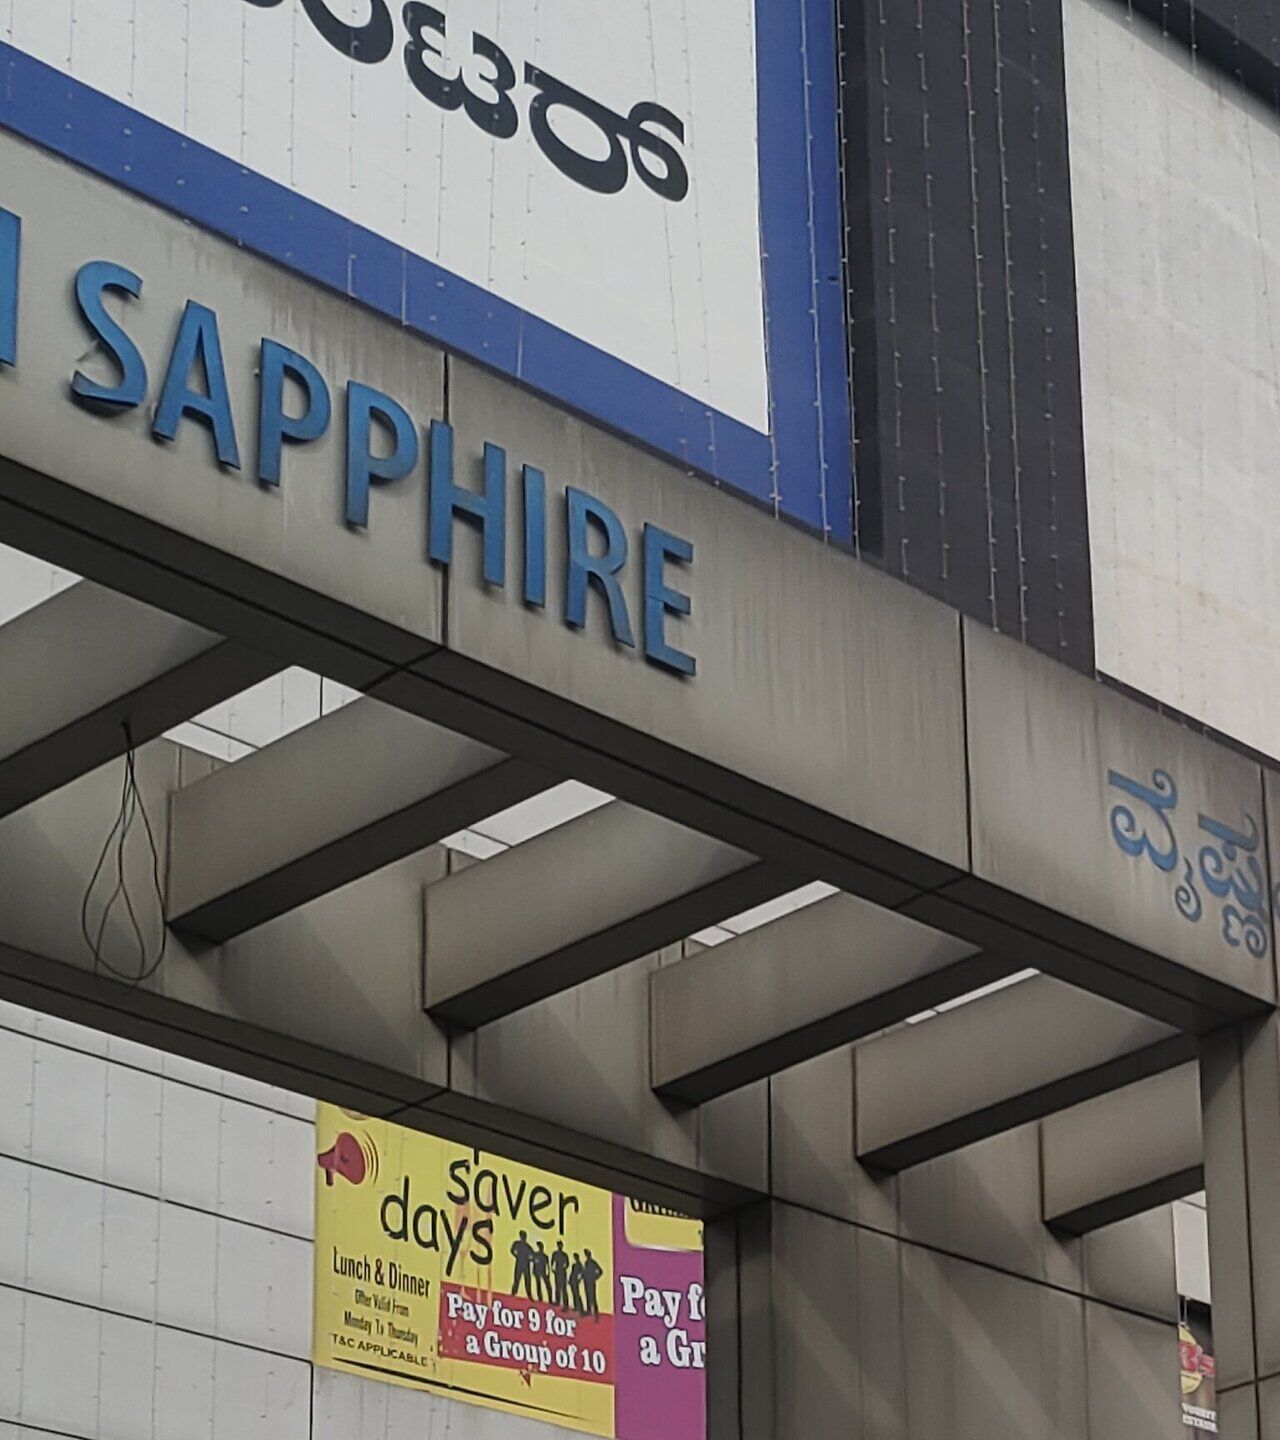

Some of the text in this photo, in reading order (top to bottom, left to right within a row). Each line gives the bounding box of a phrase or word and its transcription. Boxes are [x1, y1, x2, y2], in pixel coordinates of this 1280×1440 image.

[240, 0, 688, 202] ಂಟರ್
[69, 260, 698, 678] SAPPHIRE
[446, 1157, 579, 1236] saver
[380, 1176, 494, 1277] days
[333, 1245, 430, 1298] Lunch & Dinner
[344, 1310, 372, 1336] Monday
[446, 1292, 577, 1337] Pay for 9 for
[620, 1276, 682, 1328] Pay
[357, 1340, 428, 1367] APPLICABLE
[466, 1330, 606, 1374] a Group of 10
[640, 1335, 661, 1366] a
